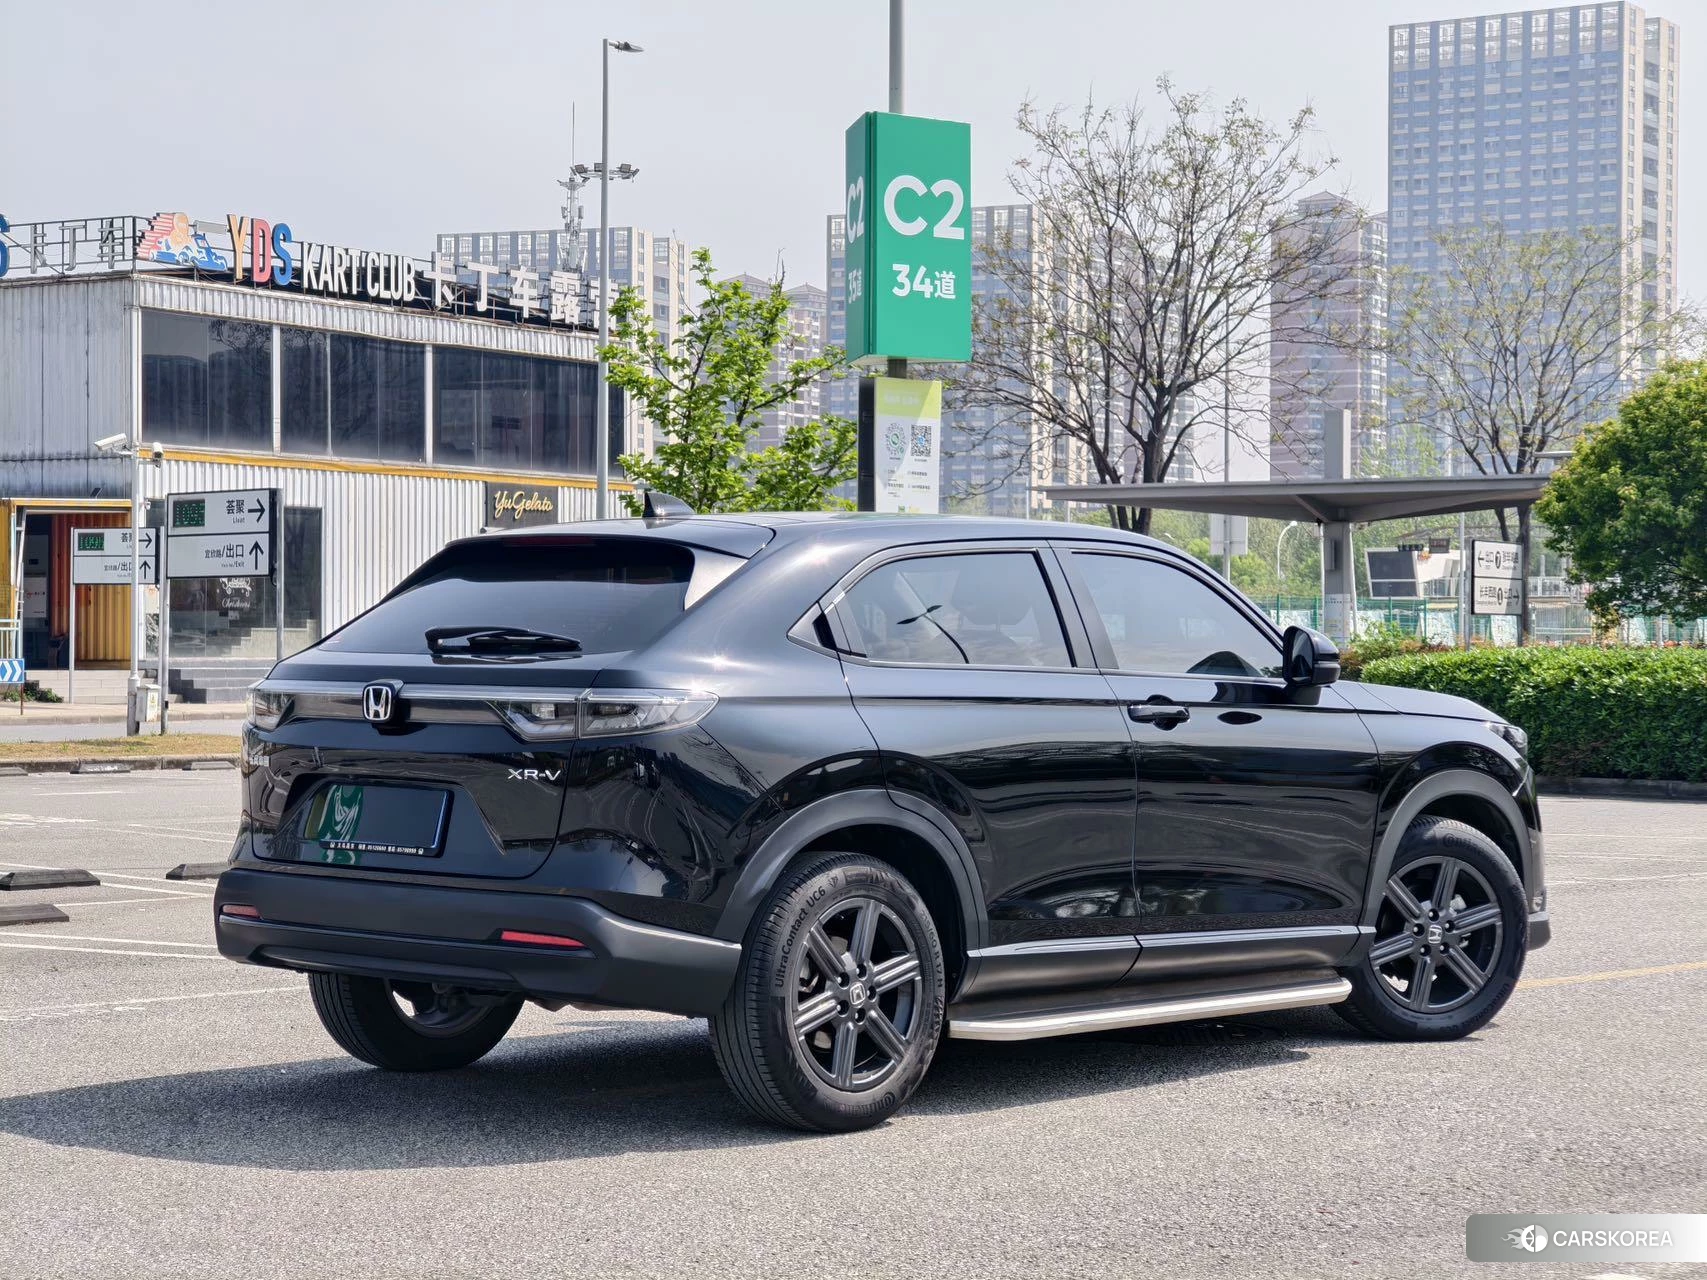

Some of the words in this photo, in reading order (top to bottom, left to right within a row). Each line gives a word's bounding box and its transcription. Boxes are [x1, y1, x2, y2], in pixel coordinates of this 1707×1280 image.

[847, 176, 864, 243] C2
[884, 175, 965, 240] C2
[226, 214, 292, 286] YDS
[302, 241, 360, 295] KART
[366, 251, 416, 301] CLUB
[892, 264, 956, 299] 34道
[226, 499, 245, 514] 荟聚
[507, 768, 562, 781] XR-V
[775, 907, 808, 987] UltraContact
[806, 886, 826, 908] UC6
